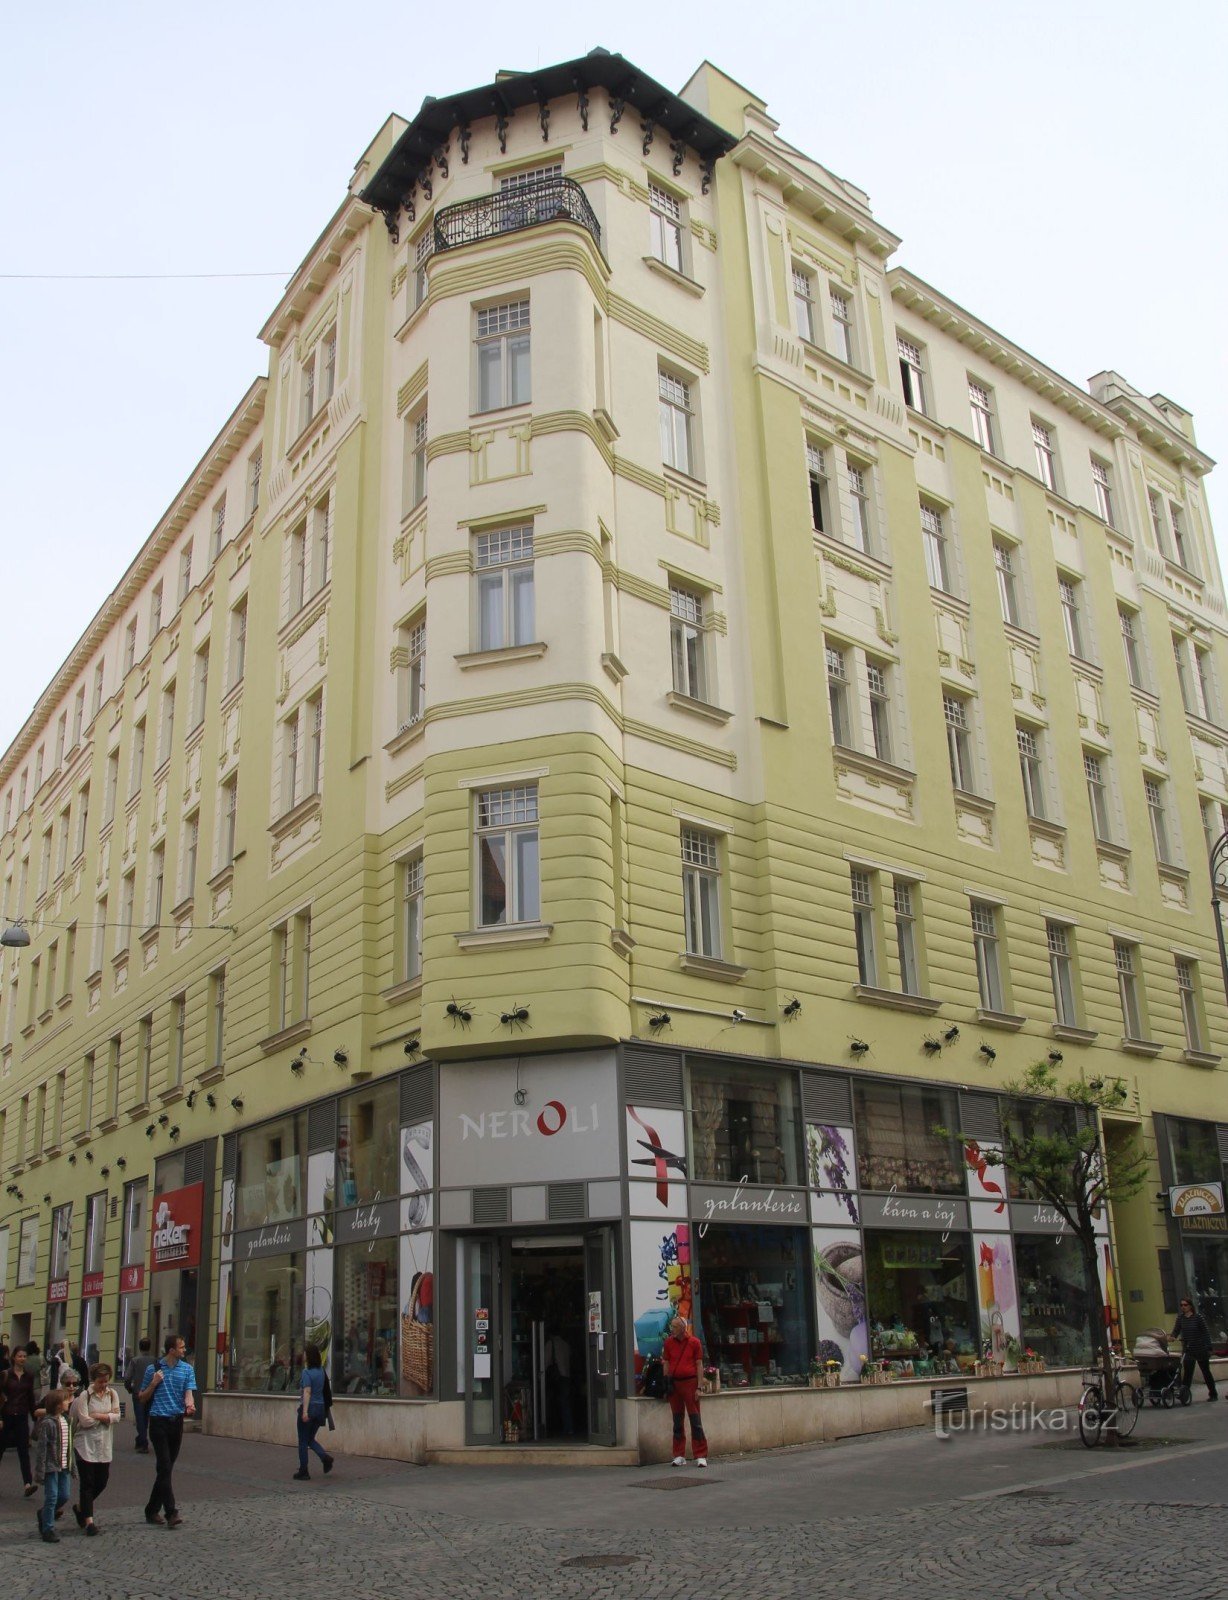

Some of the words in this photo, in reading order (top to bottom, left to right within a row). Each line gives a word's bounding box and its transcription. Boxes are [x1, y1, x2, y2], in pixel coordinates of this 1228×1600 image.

[458, 1101, 599, 1141] NEROLI
[352, 1190, 382, 1253] dárky
[699, 1174, 802, 1239] galanterie
[881, 1184, 918, 1217] káva
[921, 1210, 931, 1219] a
[935, 1201, 957, 1242] čaj
[244, 1216, 292, 1273] galanterie
